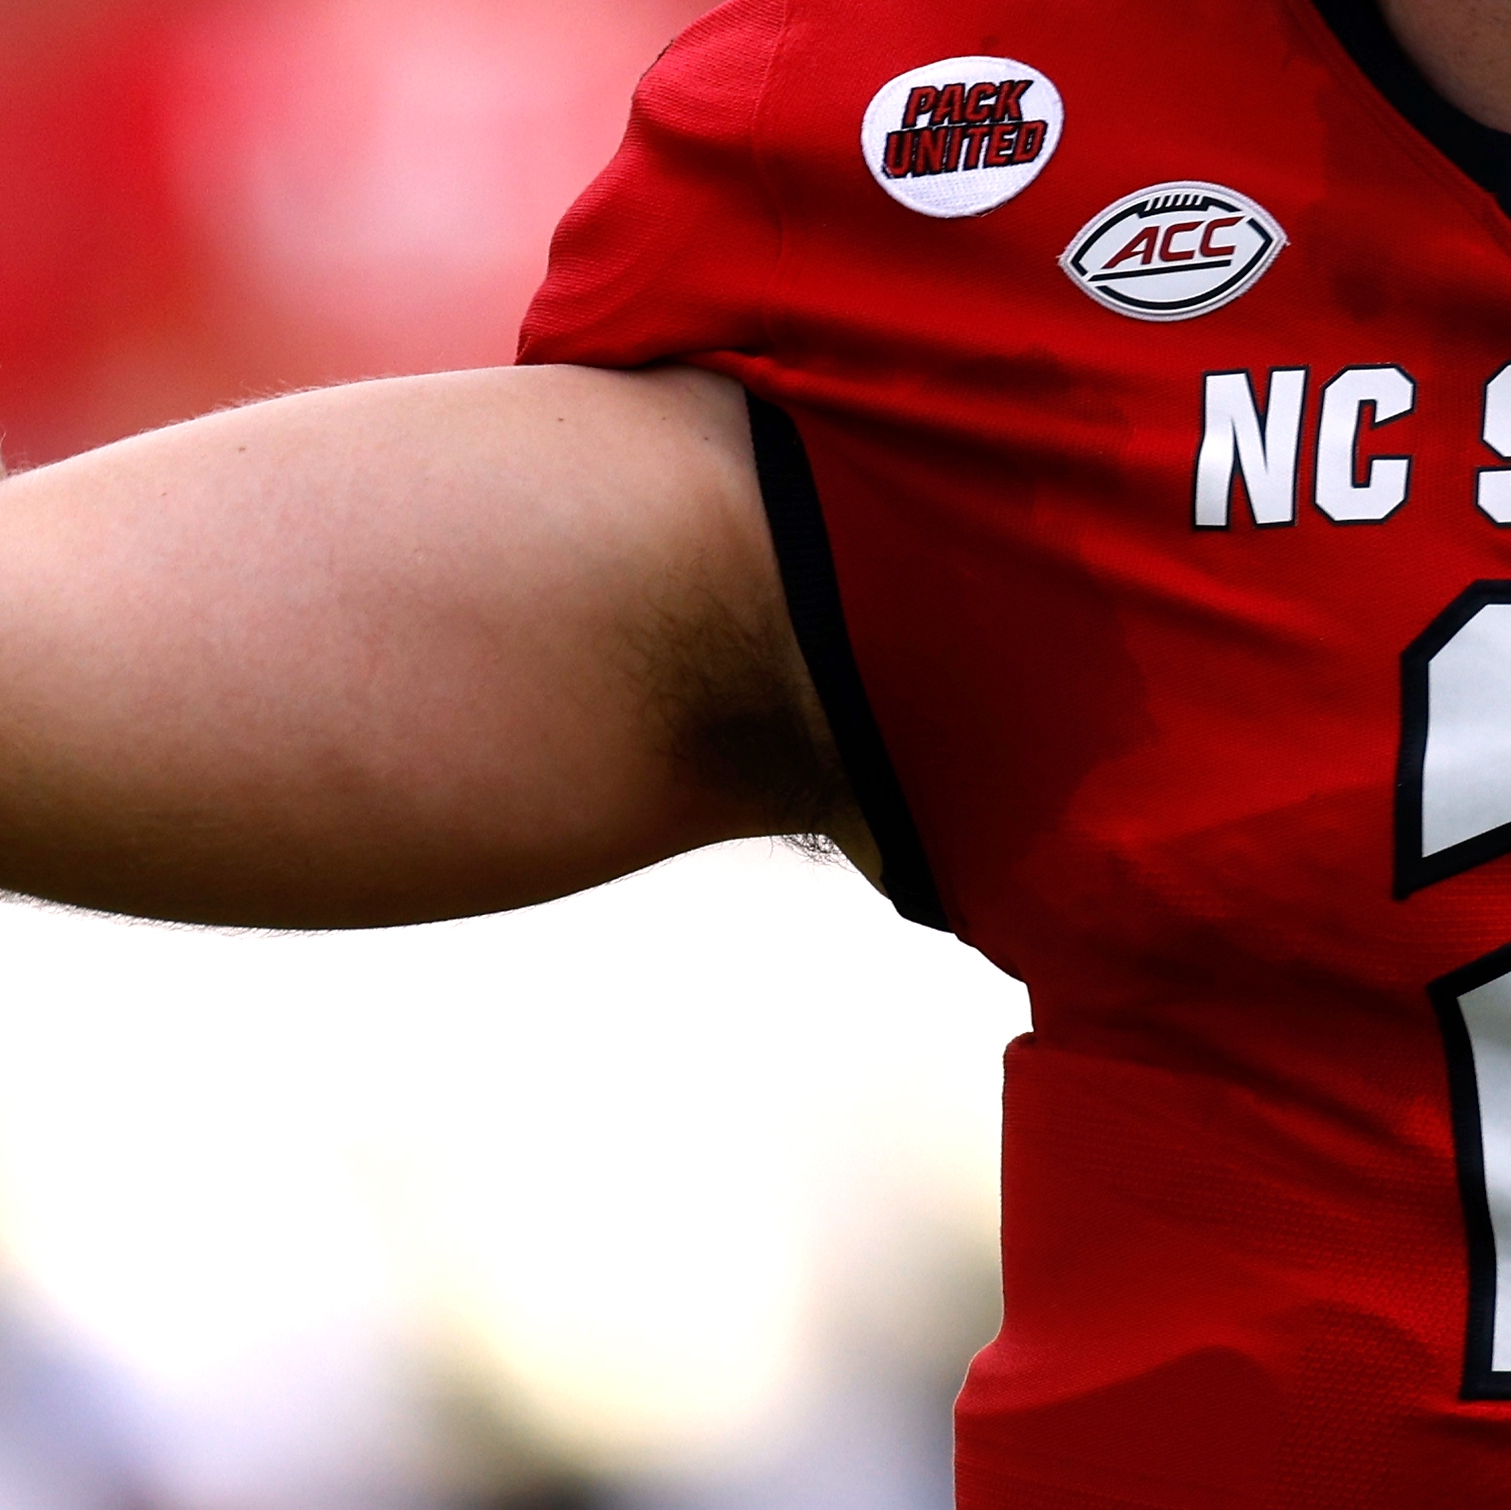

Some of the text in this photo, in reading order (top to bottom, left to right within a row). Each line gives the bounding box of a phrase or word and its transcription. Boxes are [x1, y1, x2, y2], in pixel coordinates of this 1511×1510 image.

[902, 79, 1034, 127] PACK
[882, 119, 1049, 179] UNITED
[1100, 215, 1247, 270] ACC
[1192, 362, 1418, 531] NC
